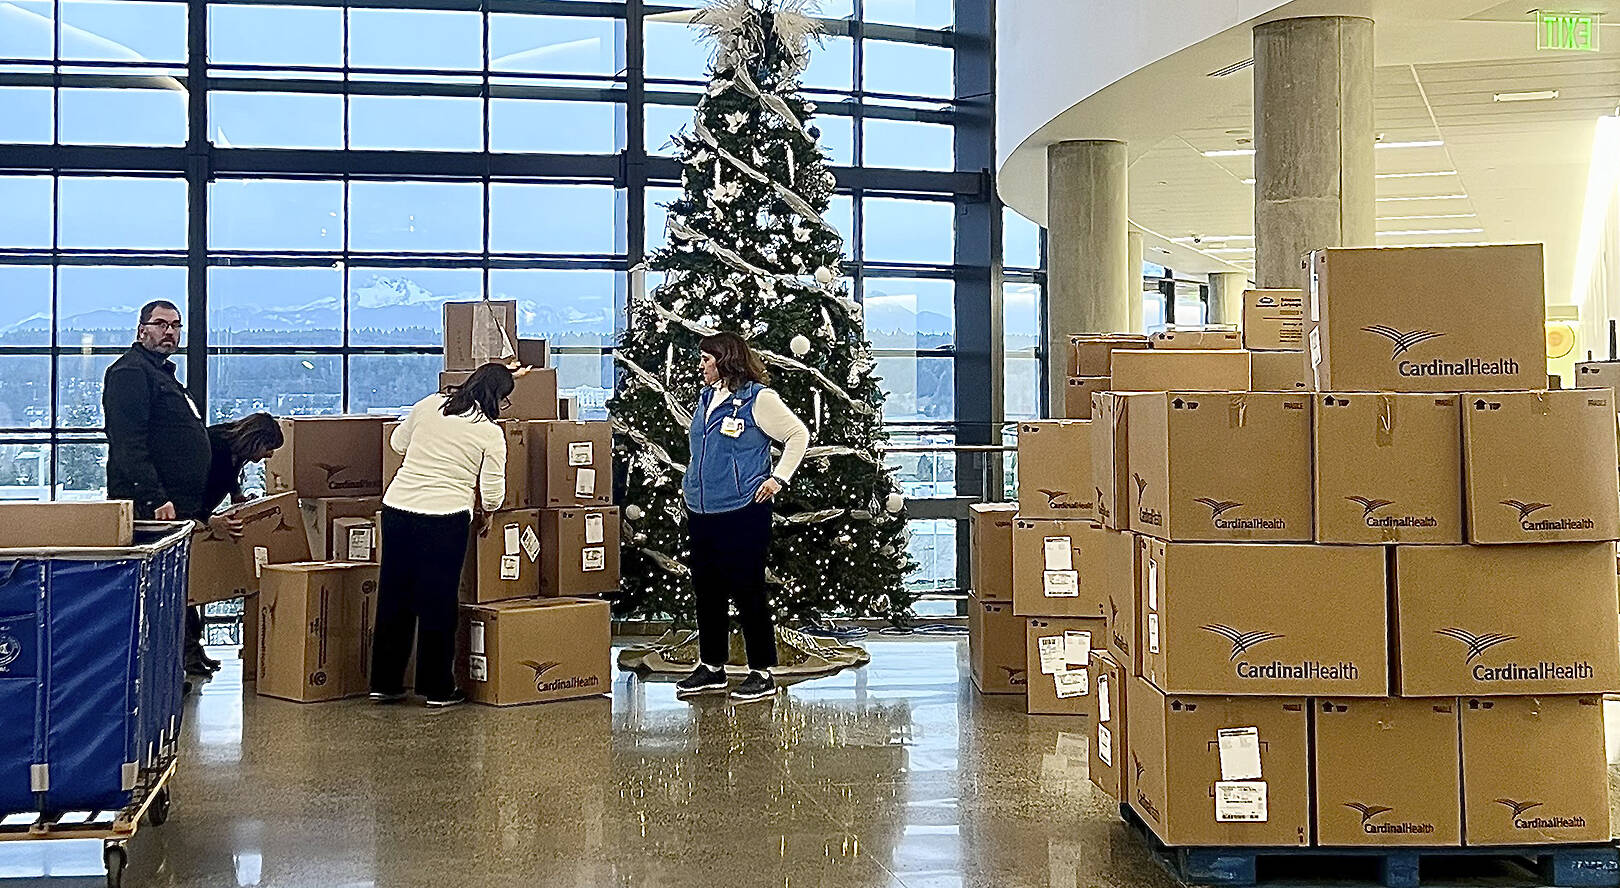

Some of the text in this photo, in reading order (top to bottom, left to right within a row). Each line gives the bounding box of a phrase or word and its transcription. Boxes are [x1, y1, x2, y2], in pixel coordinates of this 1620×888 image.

[1398, 357, 1519, 377] CardinalHealth
[1214, 517, 1286, 529] CardinalHealth
[1366, 516, 1438, 528] CardinalHealth
[1521, 518, 1594, 531] CardinalHealth
[1237, 660, 1359, 680] CardinalHealth
[1472, 660, 1594, 681] CardinalHealth
[537, 674, 599, 692] CardinalHealth
[1364, 822, 1434, 834] CardinalHealth
[1514, 816, 1585, 829] CardinalHealth
